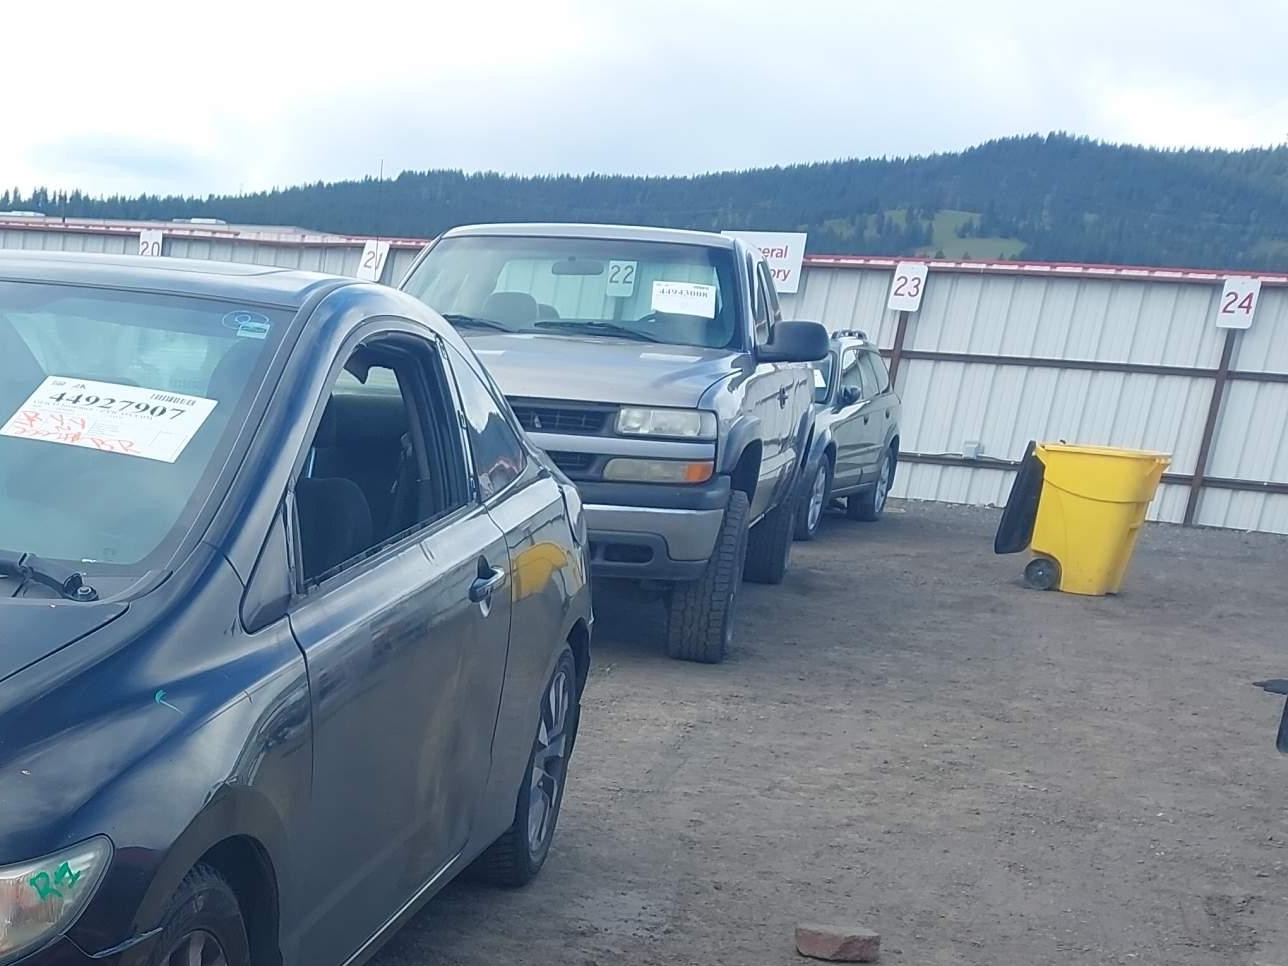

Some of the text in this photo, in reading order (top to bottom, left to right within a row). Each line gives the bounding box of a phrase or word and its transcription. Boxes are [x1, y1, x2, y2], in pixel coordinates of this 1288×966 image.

[141, 240, 161, 257] 20
[757, 244, 789, 259] eral
[363, 250, 384, 271] 21
[609, 264, 635, 285] 22
[893, 275, 922, 298] 23
[1221, 291, 1255, 315] 24
[49, 391, 187, 421] 44927907
